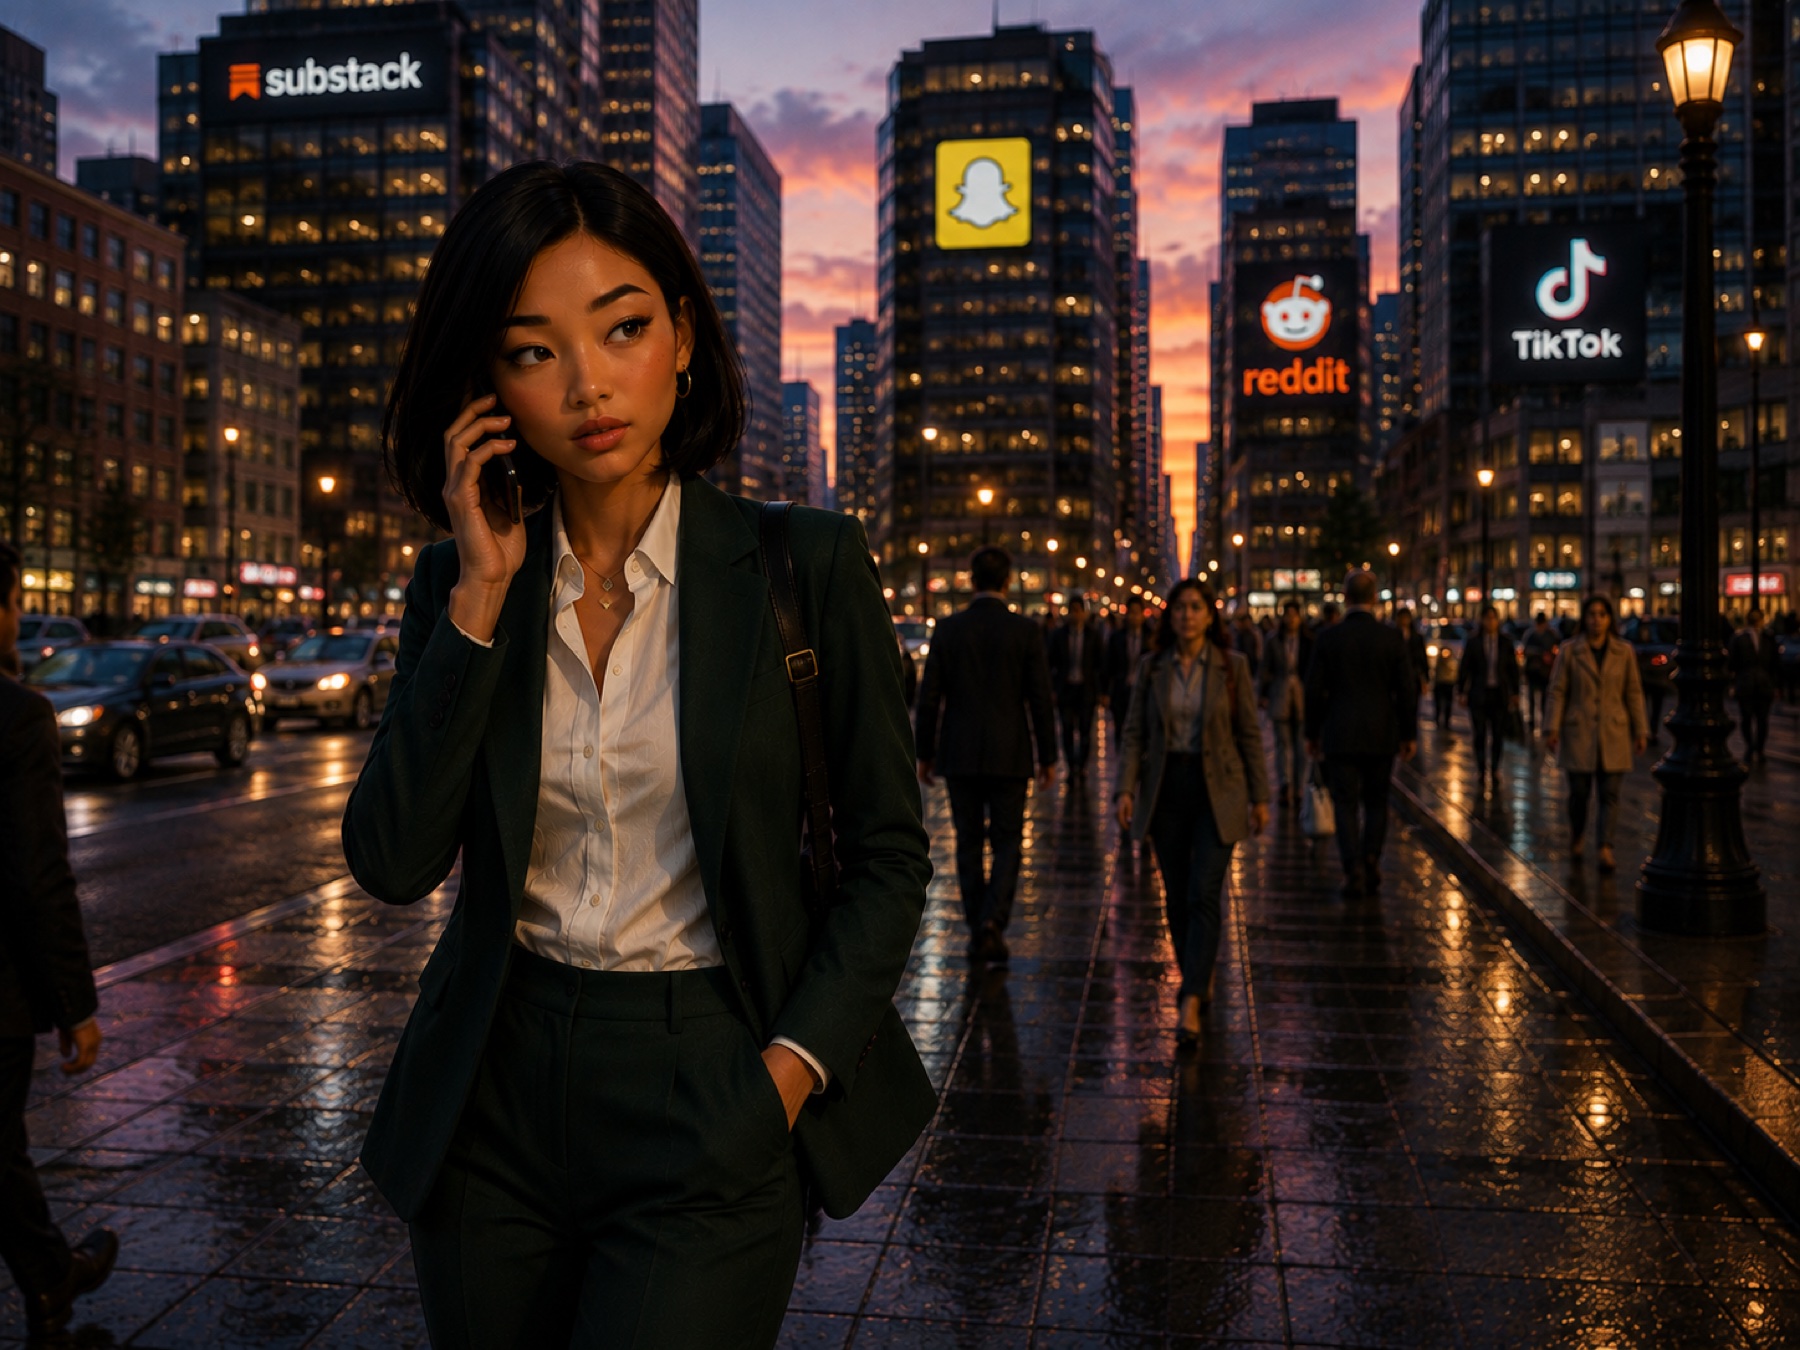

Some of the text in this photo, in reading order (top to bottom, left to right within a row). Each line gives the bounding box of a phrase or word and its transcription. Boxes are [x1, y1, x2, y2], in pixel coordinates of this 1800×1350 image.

[265, 50, 423, 97] substack
[1511, 328, 1623, 360] TikTok
[1243, 357, 1350, 396] reddit
